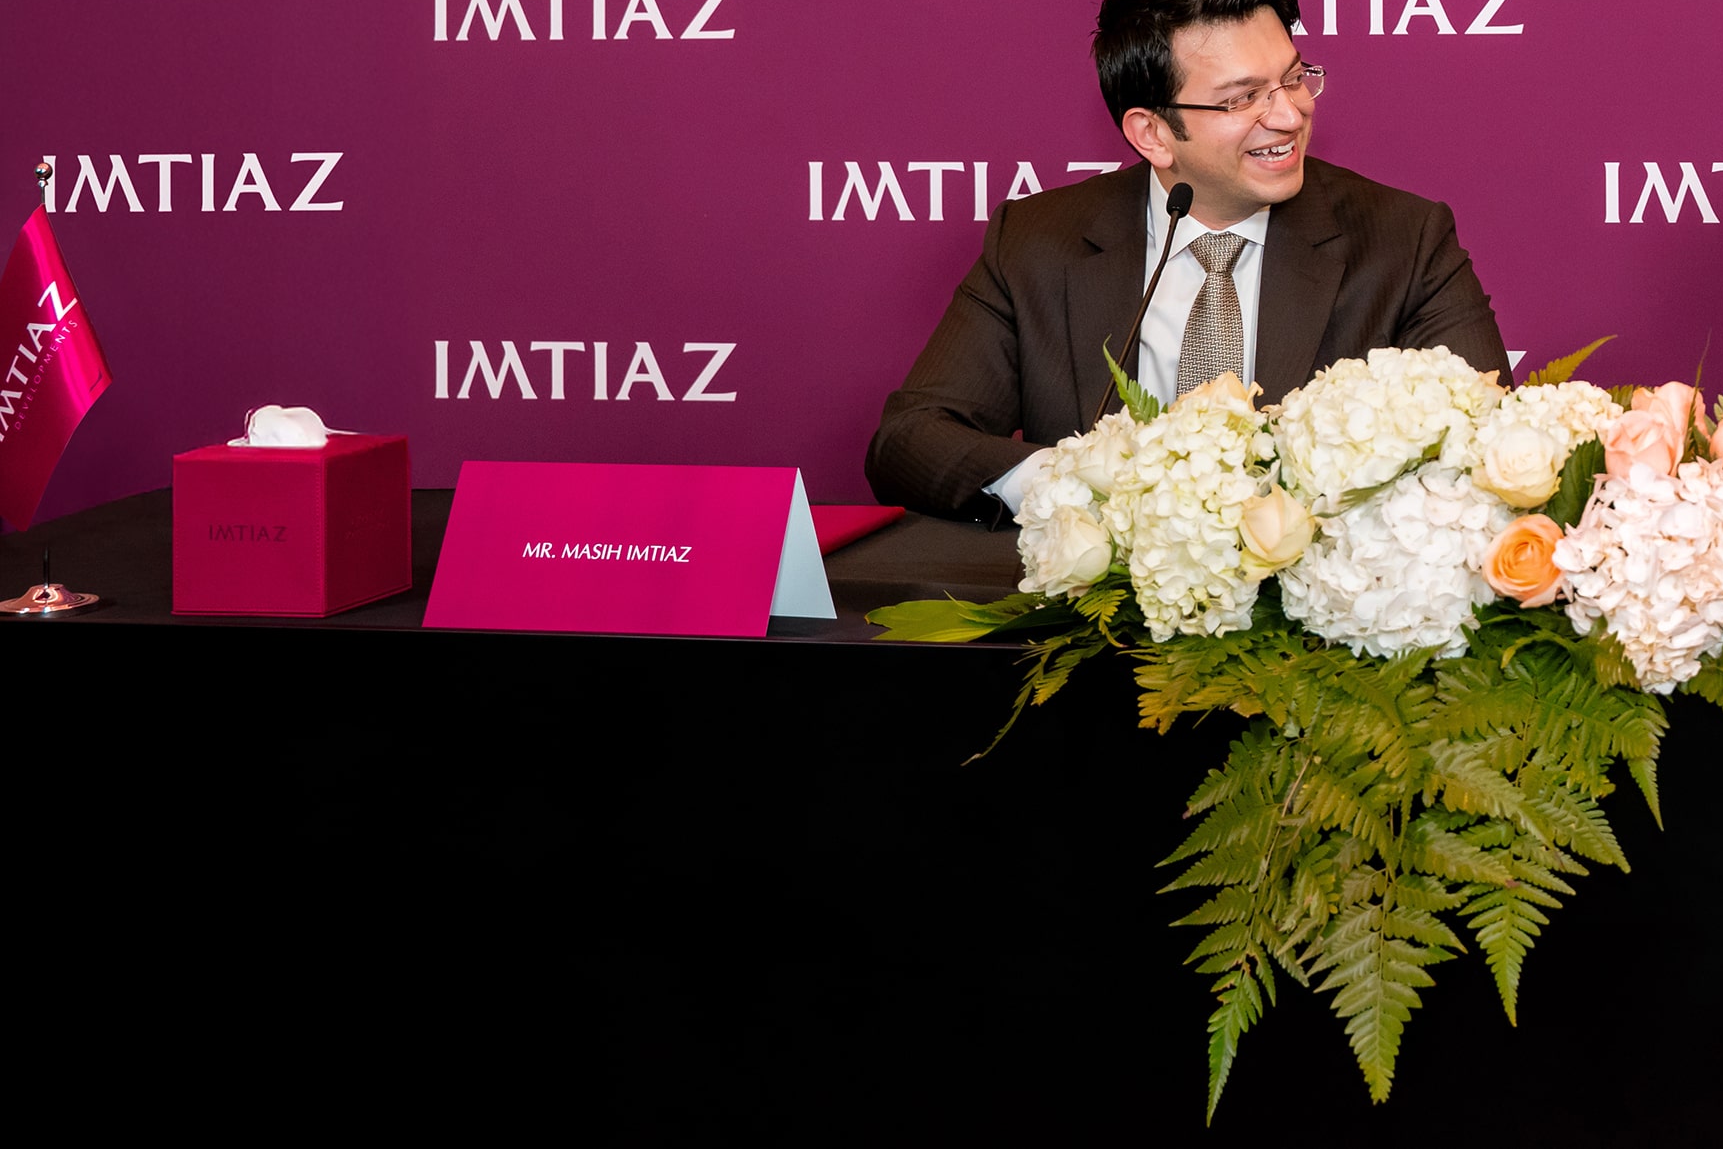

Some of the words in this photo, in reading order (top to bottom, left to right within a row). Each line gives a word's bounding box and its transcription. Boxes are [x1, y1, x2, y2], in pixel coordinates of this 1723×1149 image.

[42, 153, 344, 213] IMTIAZ
[0, 281, 78, 442] MTIAZ
[15, 319, 78, 430] DEVELOPMENTS
[435, 341, 736, 401] IMTIAZ
[208, 524, 288, 543] IMTIAZ
[522, 542, 556, 559] MR.
[561, 543, 623, 561] MASIH
[626, 545, 692, 563] IMTIAZ
